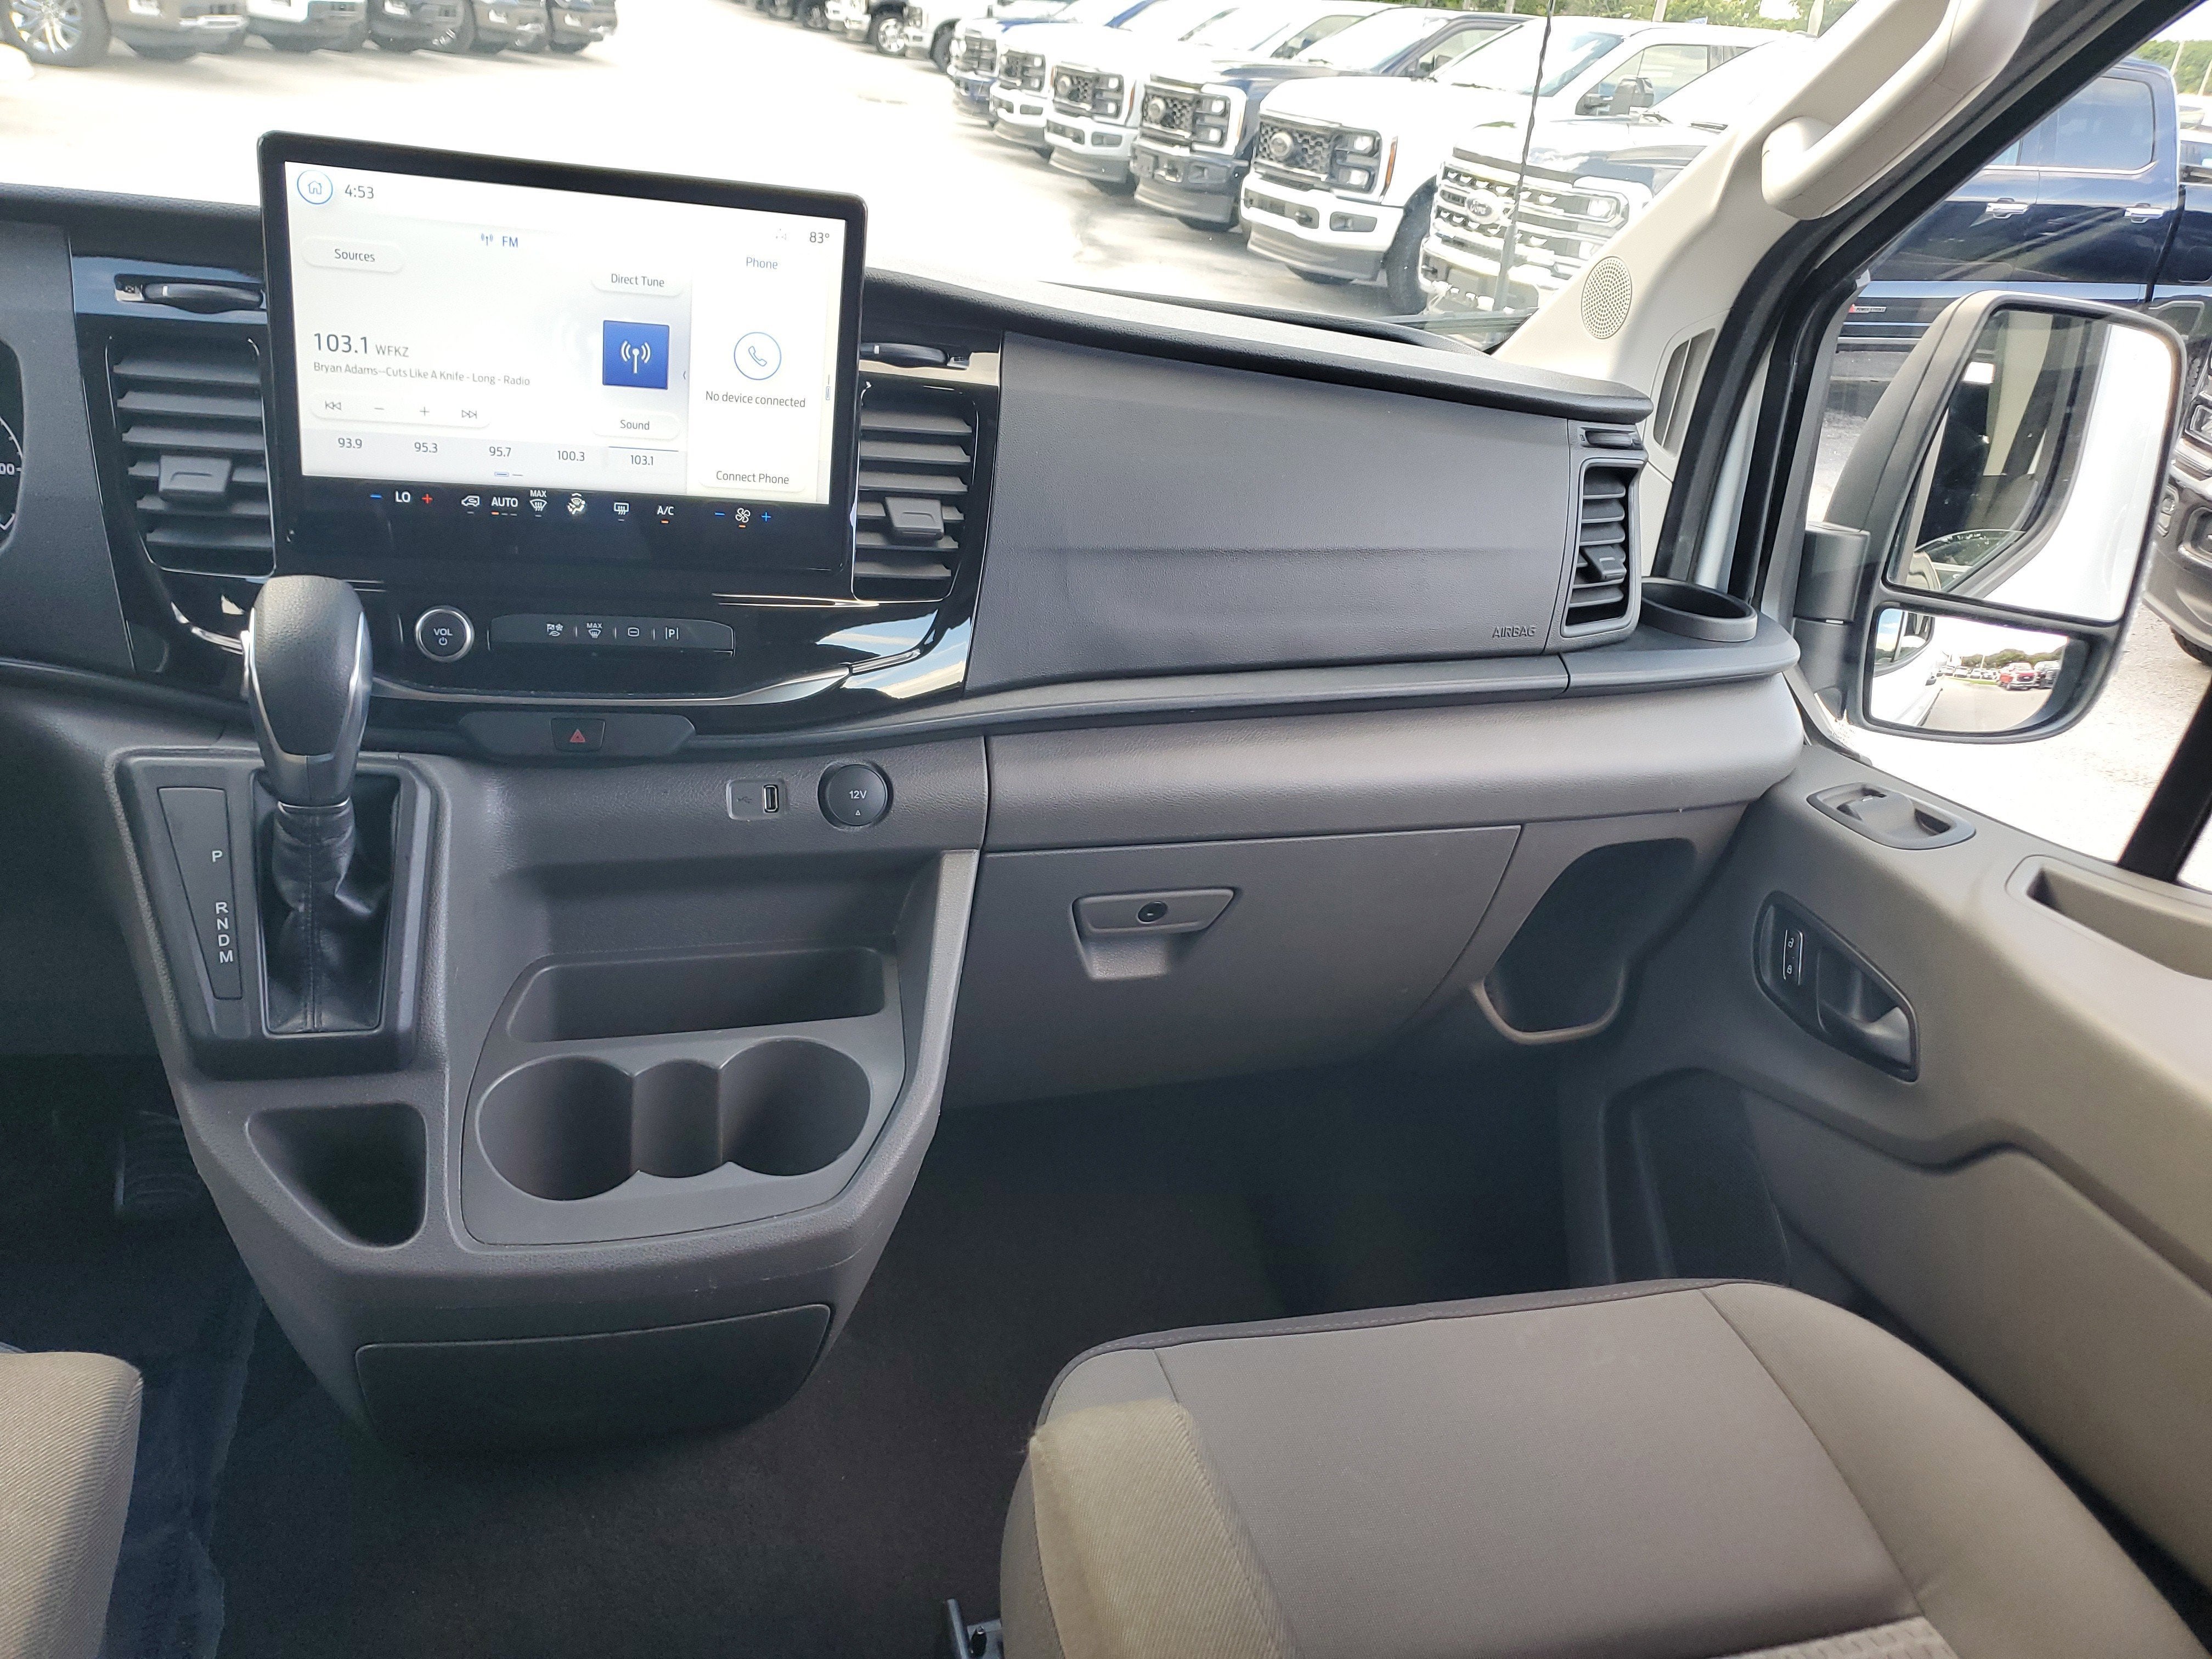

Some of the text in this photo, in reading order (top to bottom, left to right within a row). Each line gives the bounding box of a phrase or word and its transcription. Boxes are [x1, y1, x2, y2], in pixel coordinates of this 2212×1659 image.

[345, 184, 374, 199] 4:53
[502, 236, 518, 247] FM
[334, 249, 375, 262] Sources
[746, 256, 778, 269] Phone
[611, 273, 664, 287] Direct Tune
[314, 333, 409, 358] 103.1 WFKZ
[314, 362, 342, 373] Bryan
[409, 368, 428, 379] Like
[431, 370, 437, 379] A
[439, 371, 464, 381] Knife
[472, 373, 496, 385] Long
[504, 375, 530, 386] Radio
[706, 391, 806, 408] No device connected
[620, 419, 650, 430] Sound
[338, 437, 362, 449] 93.9
[414, 442, 438, 453] 95.3
[489, 446, 511, 457] 95.7
[557, 450, 585, 461] 100.3
[630, 455, 653, 466] 103.1
[716, 470, 789, 484] Connect Phone
[395, 491, 411, 503] LO
[529, 489, 547, 498] MAX
[491, 496, 518, 507] AUTO
[657, 505, 674, 516] A/C
[433, 628, 453, 636] VOL
[1492, 625, 1536, 639] AIRBAG
[849, 790, 867, 799] 12V
[212, 850, 223, 862] P
[215, 901, 229, 915] R
[217, 917, 229, 930] N
[218, 934, 230, 947] D
[219, 950, 233, 963] M
